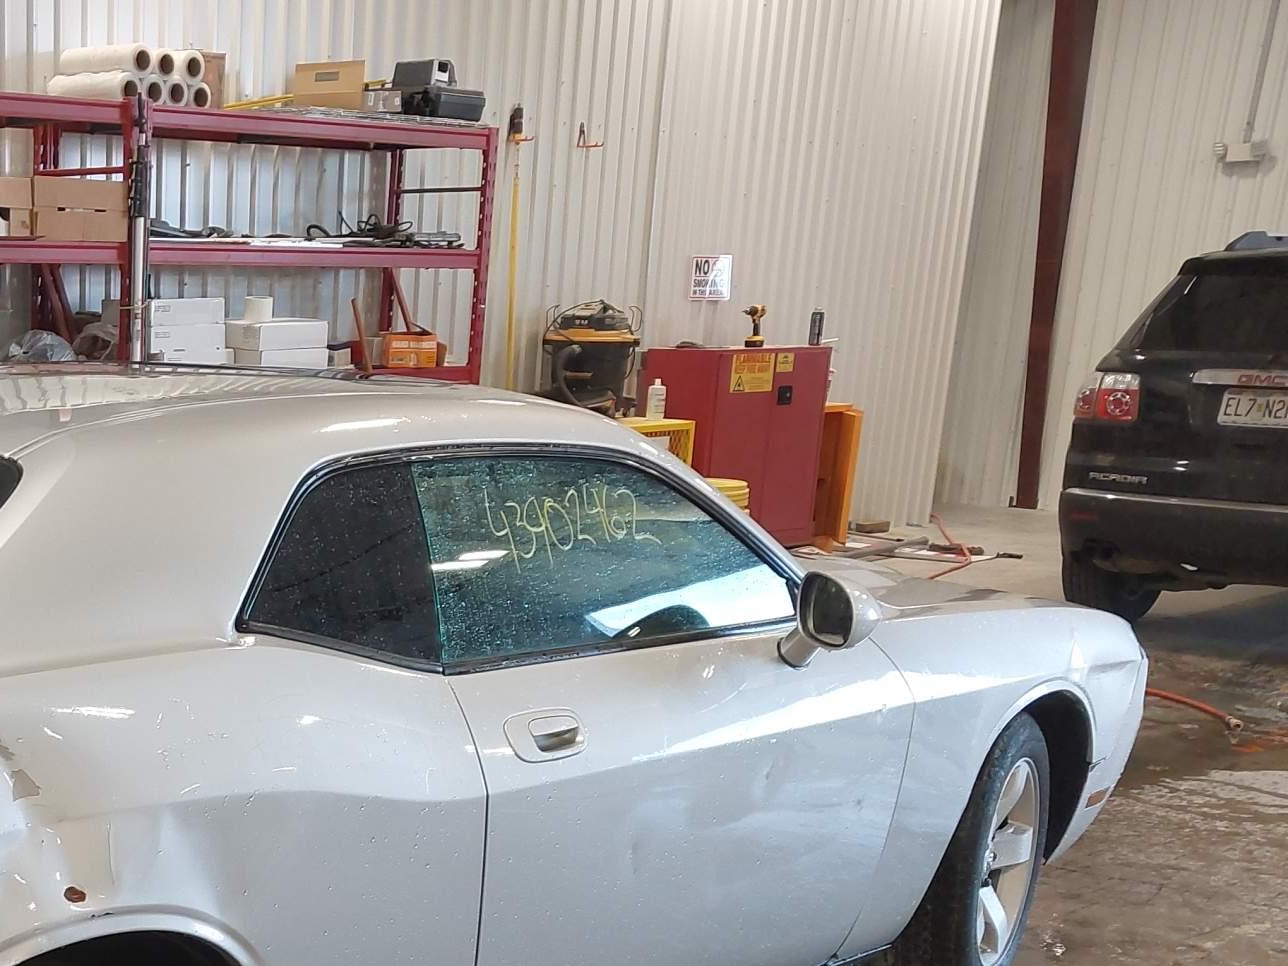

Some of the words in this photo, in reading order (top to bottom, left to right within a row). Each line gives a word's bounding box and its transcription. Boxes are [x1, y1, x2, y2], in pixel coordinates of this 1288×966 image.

[695, 259, 711, 276] NO
[693, 278, 725, 289] SMOKING
[1238, 374, 1287, 386] GMC
[1223, 396, 1258, 417] EL7
[1088, 471, 1149, 485] ACADIA
[484, 483, 663, 574] 43902462
